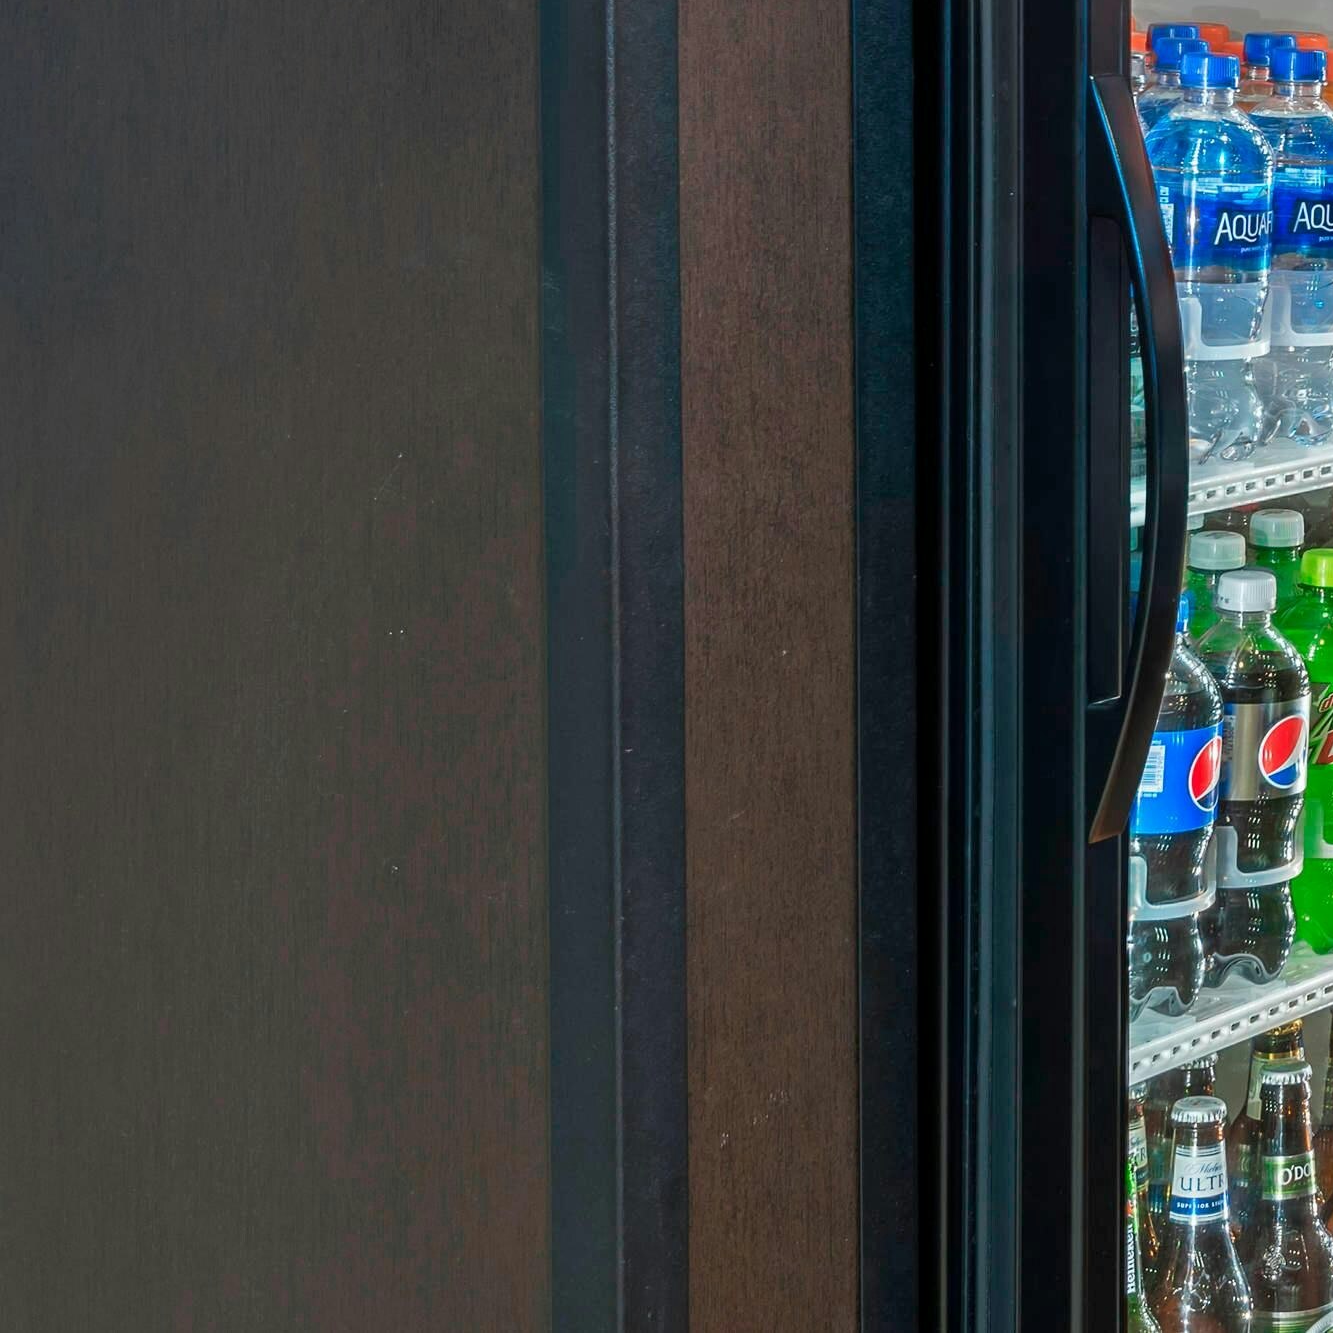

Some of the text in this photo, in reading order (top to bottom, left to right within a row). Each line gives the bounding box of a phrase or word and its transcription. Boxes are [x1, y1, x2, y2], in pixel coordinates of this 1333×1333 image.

[1213, 211, 1273, 246] AQUAF
[1180, 1176, 1225, 1192] ULTR
[1126, 1223, 1134, 1295] Heineken
